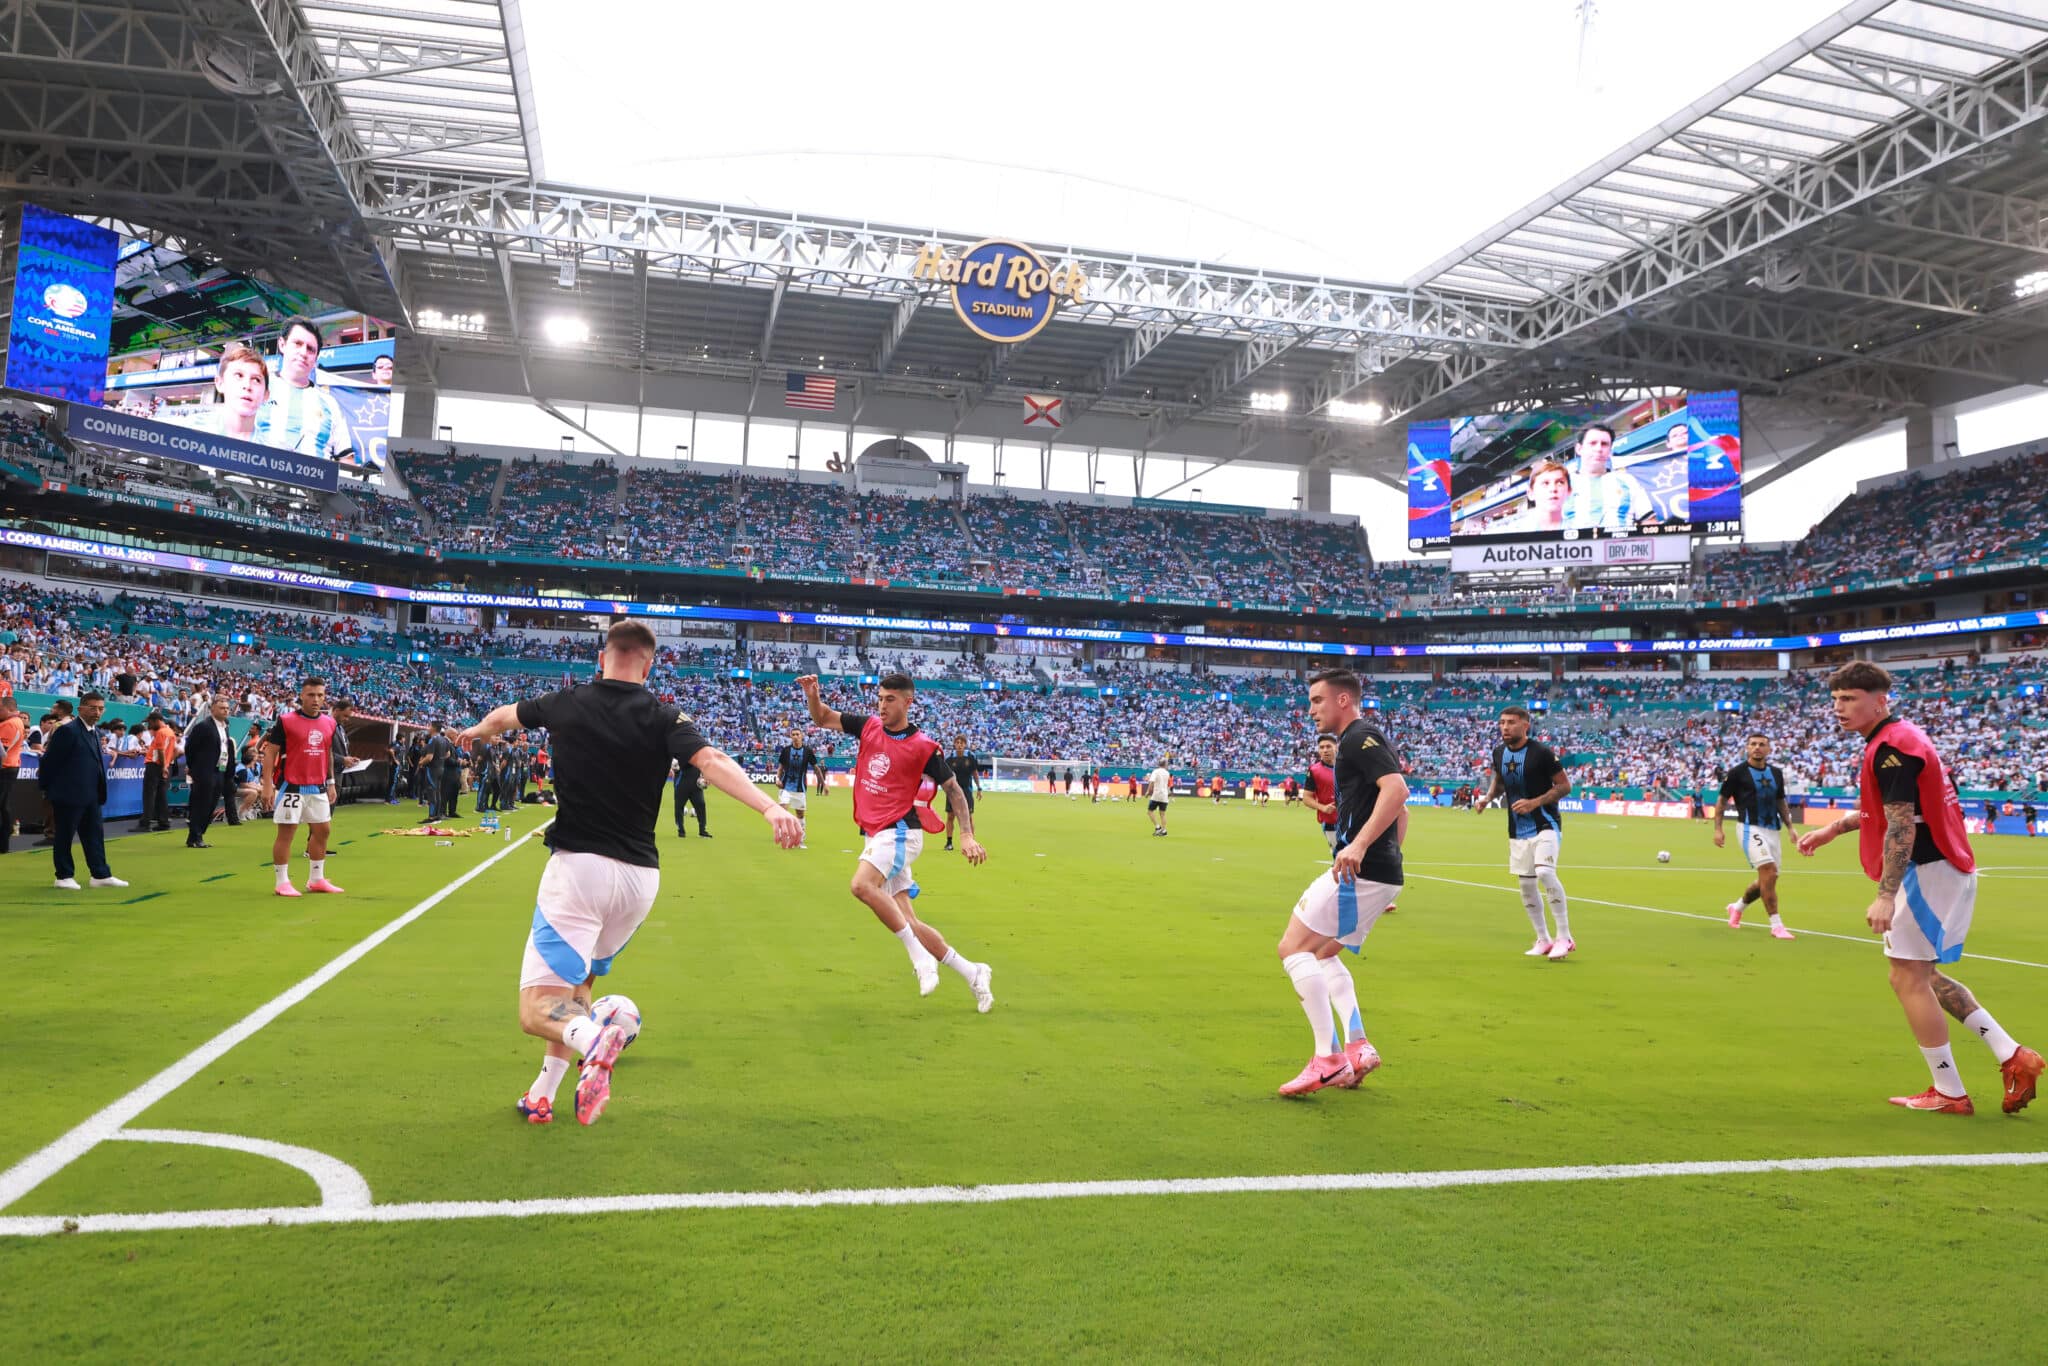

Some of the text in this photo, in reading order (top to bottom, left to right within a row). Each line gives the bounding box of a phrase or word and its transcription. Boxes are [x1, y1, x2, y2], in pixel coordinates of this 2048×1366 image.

[913, 244, 1087, 304] Hard Rock
[972, 301, 1033, 319] STADIUM
[27, 316, 53, 329] COPA
[54, 323, 97, 340] AMERICA
[83, 418, 325, 480] CONMEBOL COPA AMERICA USA 2024
[87, 488, 157, 508] SUPER BOWL VII
[202, 508, 326, 538] 1972 PERFECT SEASON TEAM 17-0
[1726, 521, 1739, 533] PM
[6, 531, 42, 547] COPA
[43, 536, 99, 555] AMERICA
[103, 545, 125, 558] USA
[128, 549, 156, 562] 2024
[361, 538, 382, 548] SUPER
[383, 543, 401, 551] BOWL
[1609, 544, 1649, 558] DRV PNK
[1483, 544, 1593, 563] AutoNation
[230, 565, 354, 590] ROCKING THE CONTINENT
[940, 584, 966, 592] TAYLOR
[410, 591, 585, 610] CONMEBOL COPA AMERICA USA 2024
[815, 614, 865, 626] CONMEBOL
[866, 617, 891, 628] COPA
[890, 618, 930, 630] AMERICA
[1699, 638, 1773, 649] CONTINENTE
[106, 768, 138, 779] CONMEBOL
[283, 794, 300, 808] 22
[1558, 800, 1583, 809] ULTRA
[1753, 834, 1763, 846] 5
